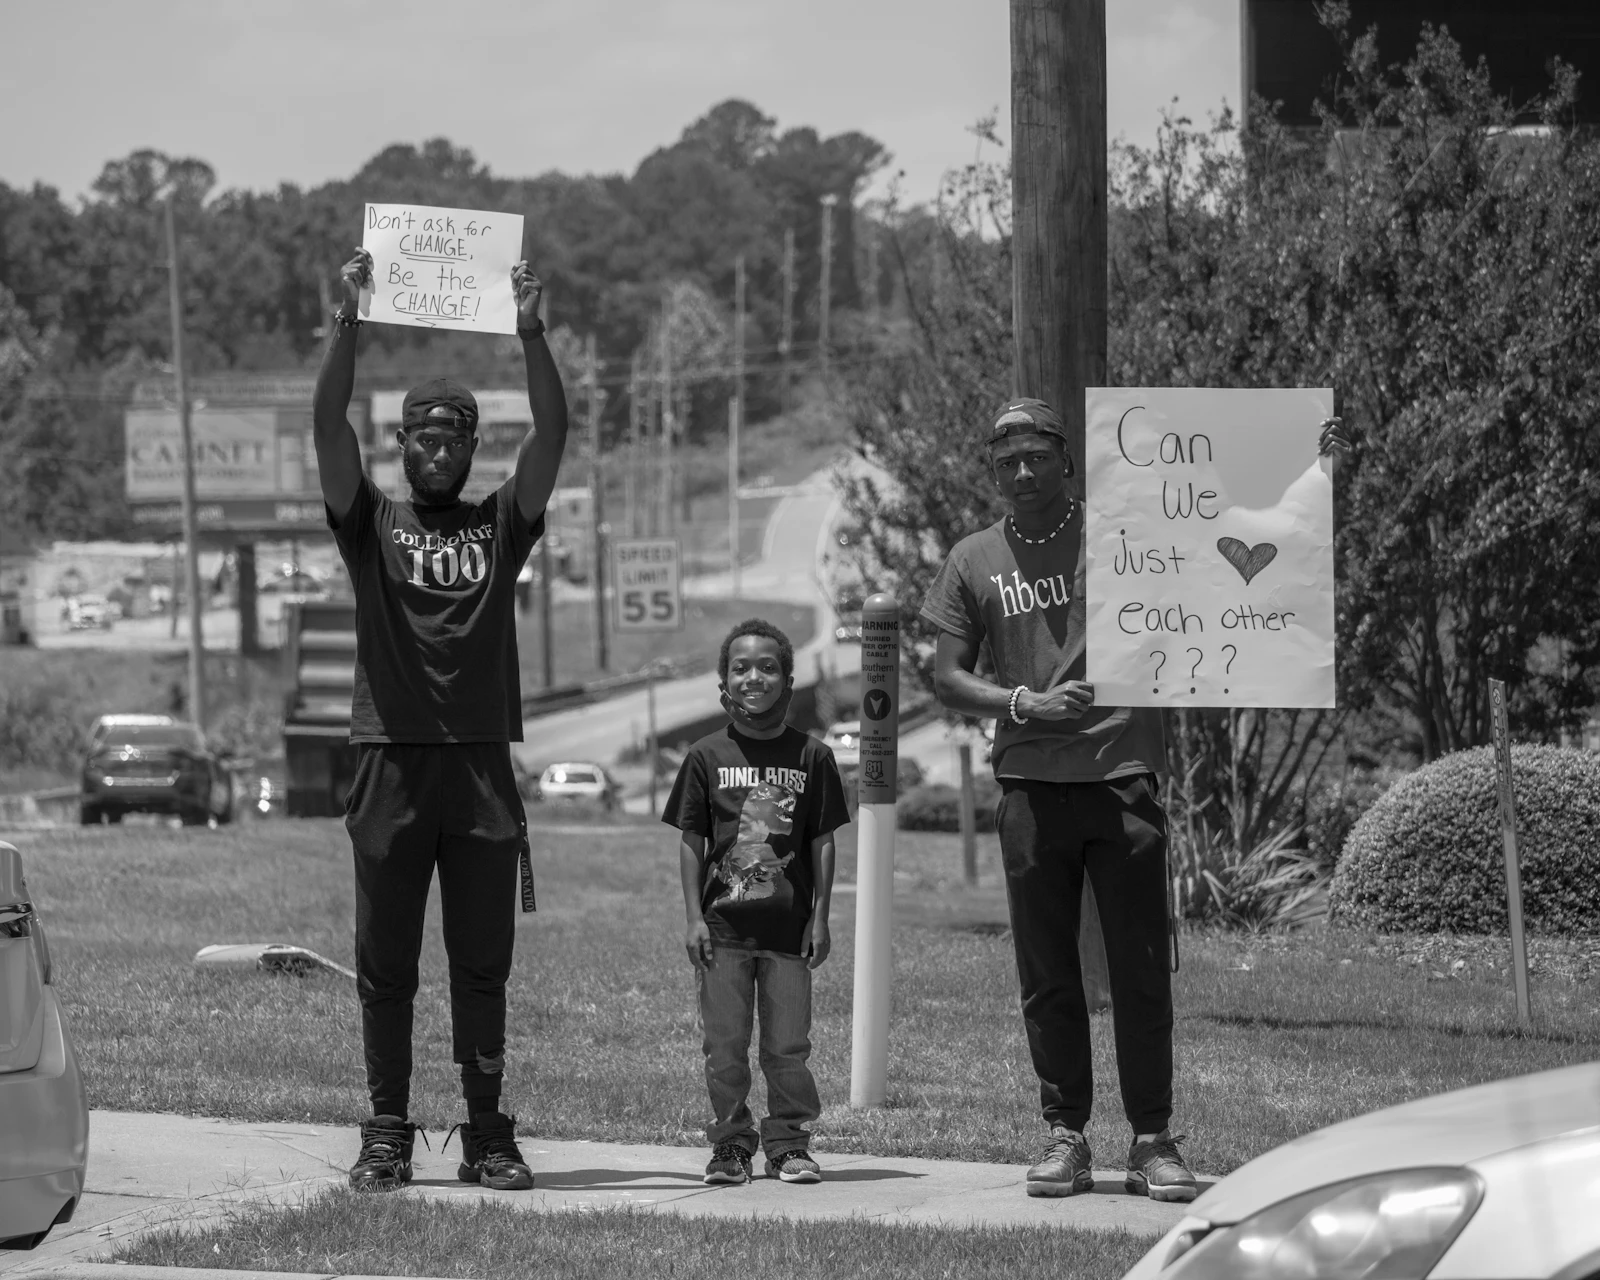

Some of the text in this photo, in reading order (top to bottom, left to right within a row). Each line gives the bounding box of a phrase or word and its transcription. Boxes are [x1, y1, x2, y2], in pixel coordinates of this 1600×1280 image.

[369, 206, 492, 237] Don't ask for
[399, 234, 474, 260] CHANGE,
[388, 262, 477, 291] Be the
[392, 291, 481, 322] CHANGE!
[1117, 406, 1212, 467] Can
[130, 440, 267, 465] CAINET
[1163, 480, 1219, 520] We
[392, 524, 493, 552] COLLEGIATE
[1114, 528, 1186, 576] just
[407, 543, 486, 587] 100
[619, 547, 674, 563] SPEED
[622, 568, 669, 586] LIMIT
[622, 590, 675, 623] 55
[1118, 602, 1296, 635] each other
[867, 673, 885, 684] light
[717, 766, 759, 789] DINO
[866, 760, 883, 773] 811
[523, 878, 535, 912] NATIO
